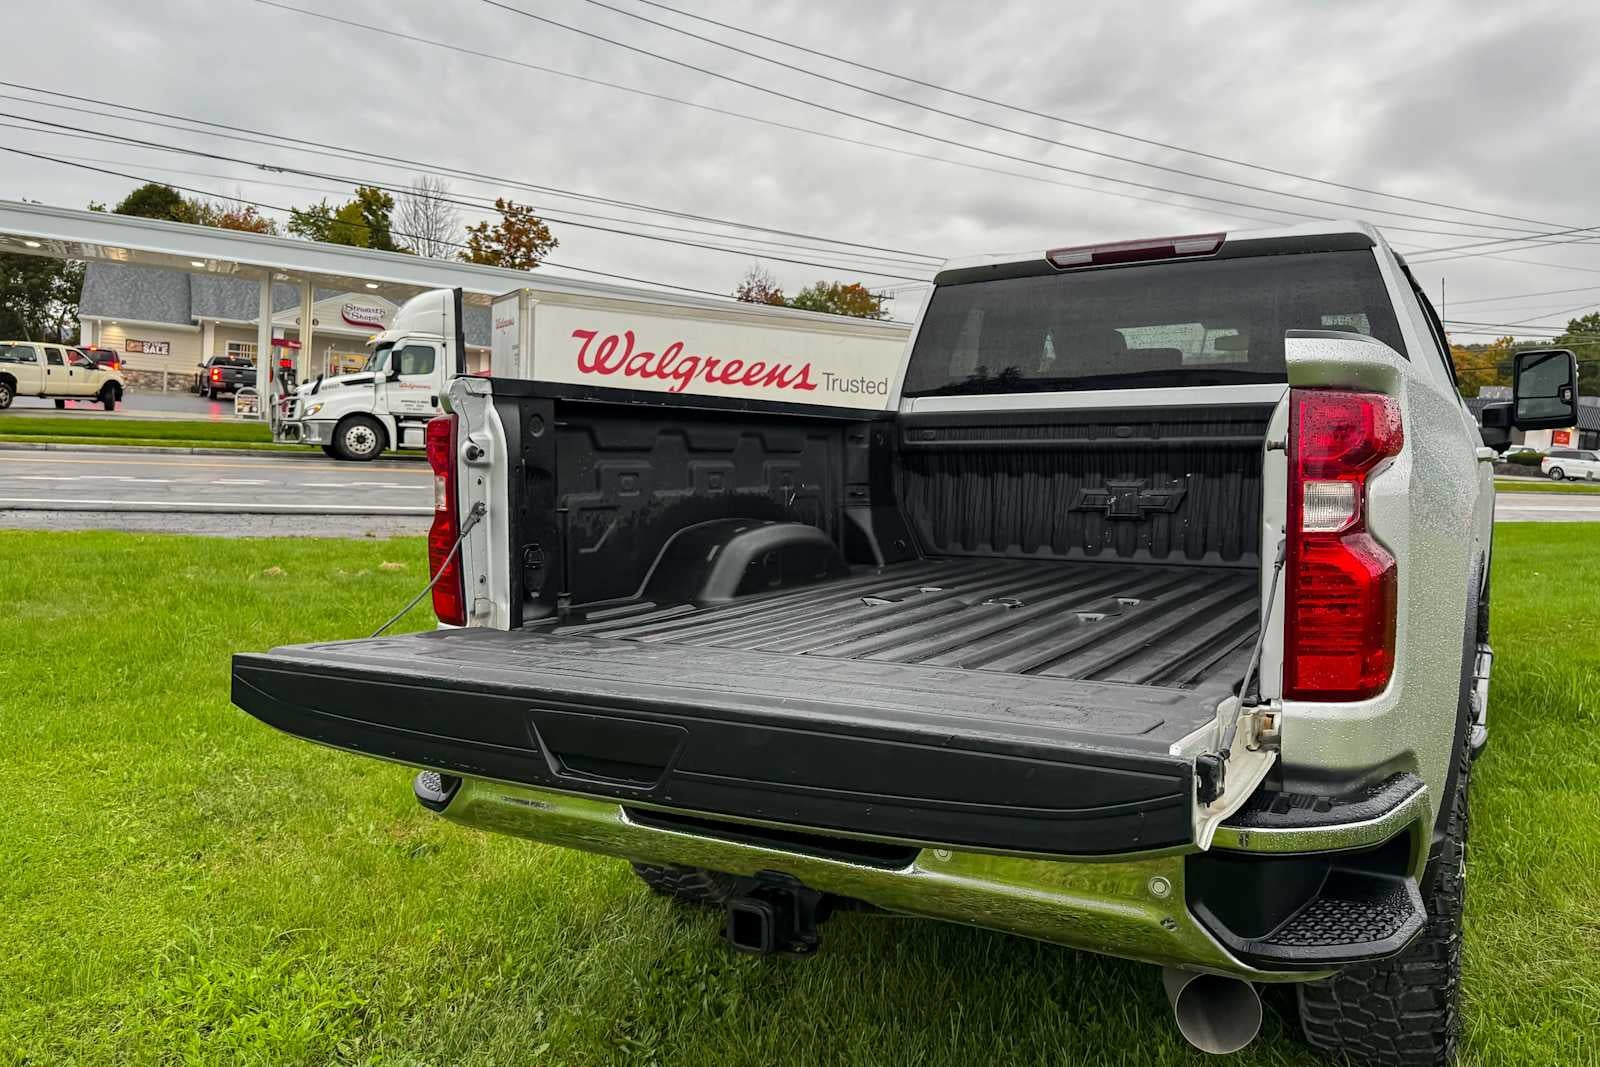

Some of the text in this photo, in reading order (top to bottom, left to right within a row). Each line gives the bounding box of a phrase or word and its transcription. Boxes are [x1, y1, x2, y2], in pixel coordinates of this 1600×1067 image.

[143, 343, 169, 354] SALE
[572, 329, 889, 396] Walgreens Trusted
